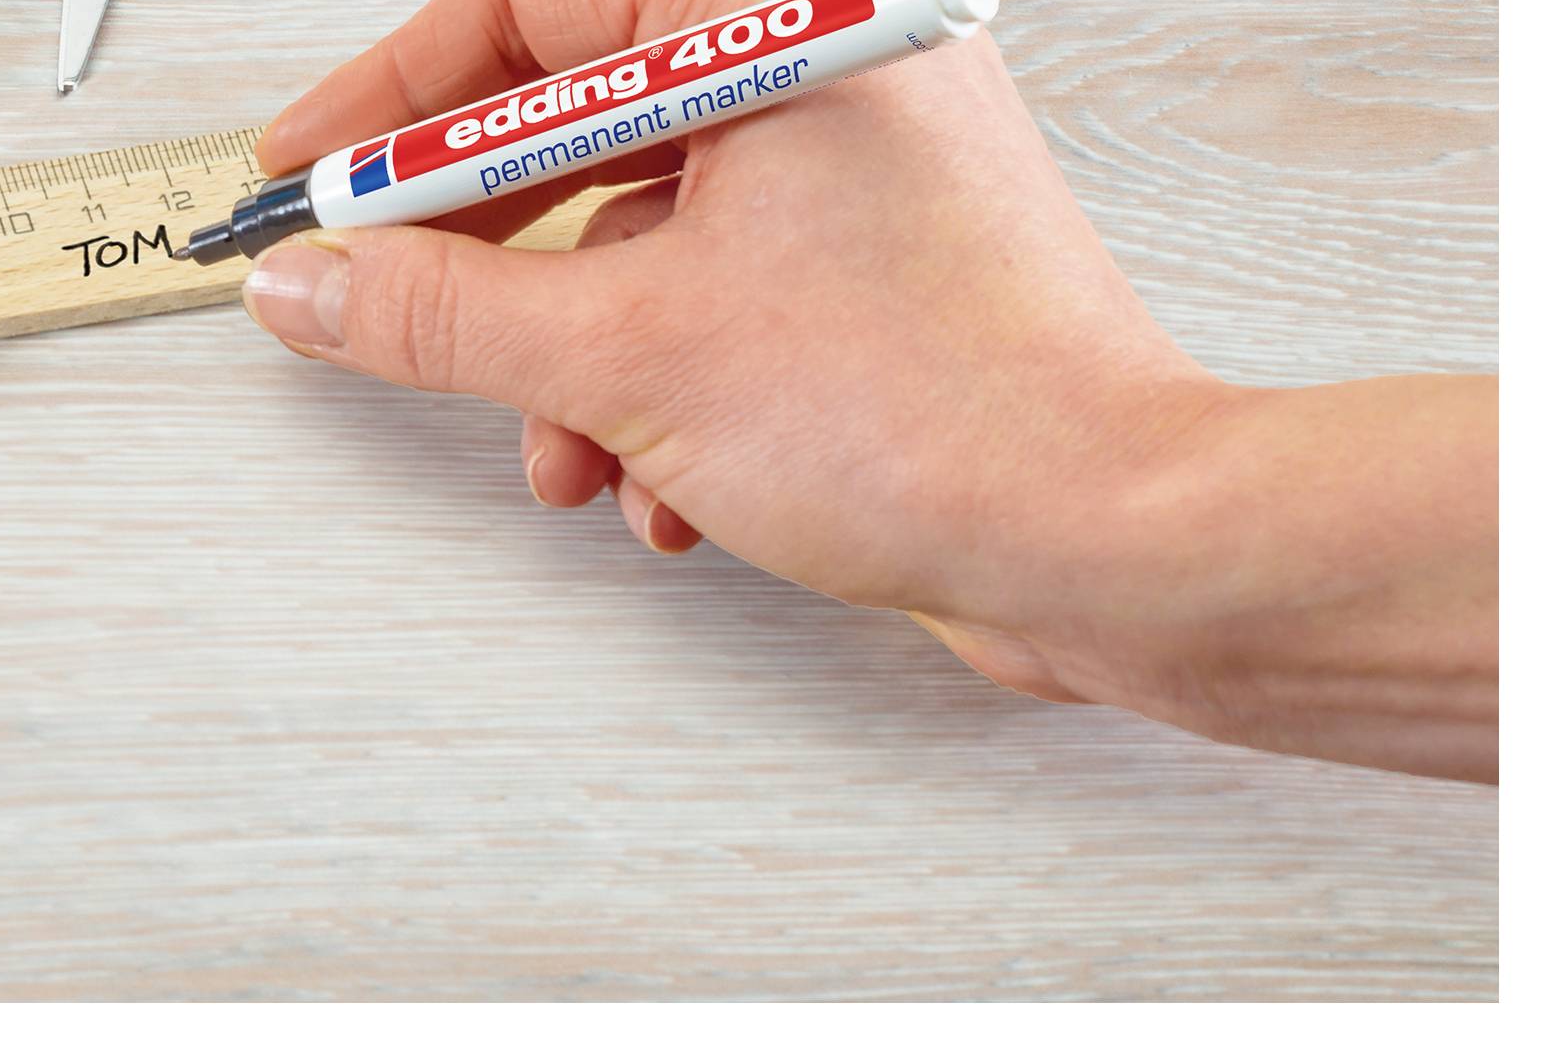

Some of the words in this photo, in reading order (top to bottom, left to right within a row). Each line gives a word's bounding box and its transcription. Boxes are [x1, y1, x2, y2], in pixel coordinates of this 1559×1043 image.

[444, 58, 649, 151] edding
[478, 104, 672, 195] permanent
[680, 53, 810, 118] marker
[81, 202, 108, 224] 11
[158, 189, 195, 213] 12
[62, 224, 174, 277] TOM
